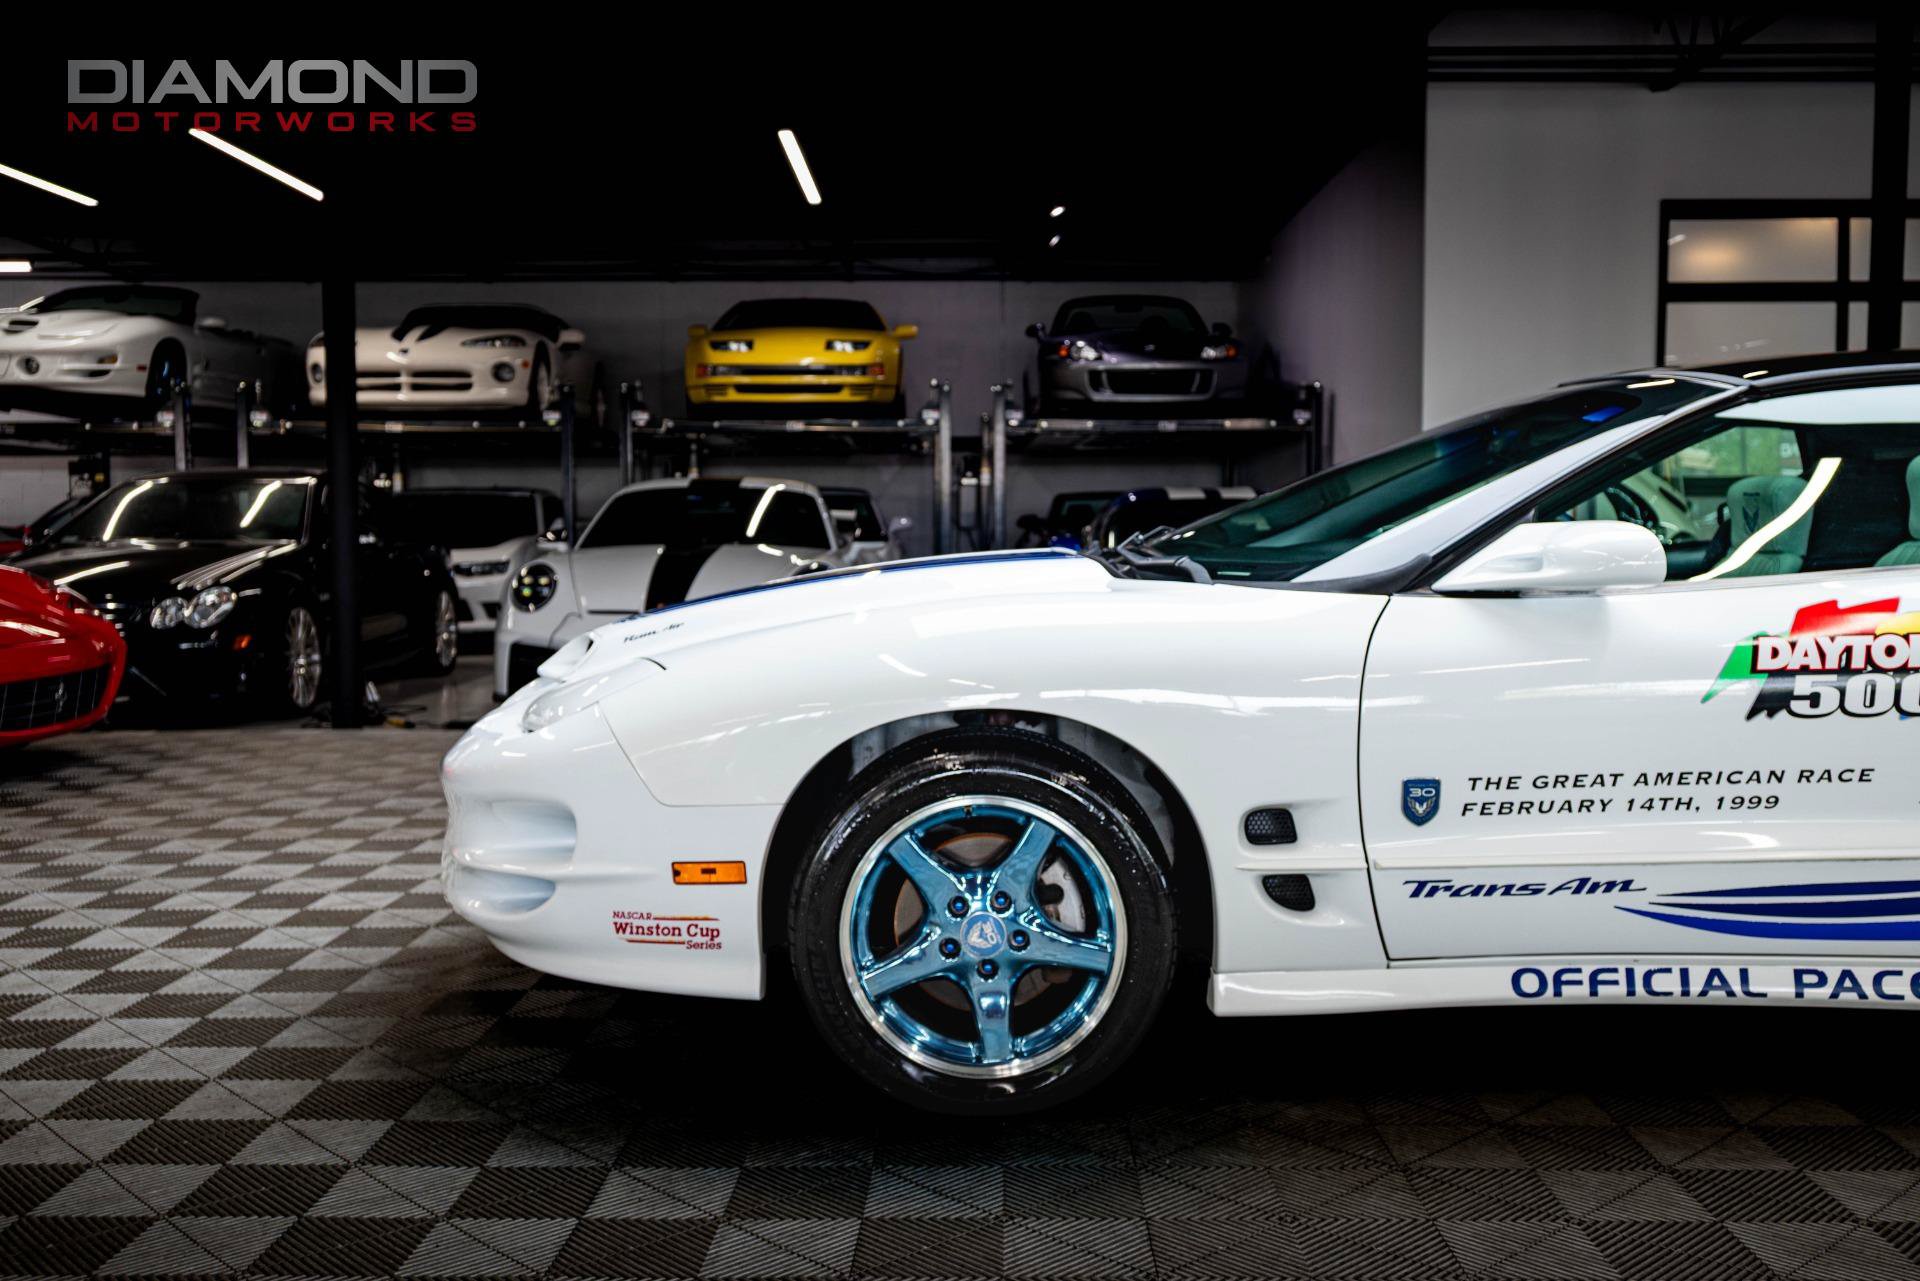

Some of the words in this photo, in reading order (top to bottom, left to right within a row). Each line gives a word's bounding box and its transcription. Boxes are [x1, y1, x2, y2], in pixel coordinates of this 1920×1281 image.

[1468, 776, 1522, 791] THE
[1532, 773, 1625, 790] GREAT
[1634, 770, 1786, 787] AMERICAN
[1798, 768, 1876, 783] RACE
[1409, 788, 1436, 797] 30
[1462, 798, 1613, 817] FEBRUARY
[1626, 796, 1700, 813] 14TH,
[1716, 795, 1780, 811] 1999
[1403, 880, 1546, 898] Trans
[1548, 877, 1648, 896] Am
[612, 910, 652, 921] NASCAR
[613, 922, 682, 937] Winston
[686, 924, 720, 941] Cup
[686, 940, 722, 950] Series
[1511, 967, 1768, 998] OFFICIAL
